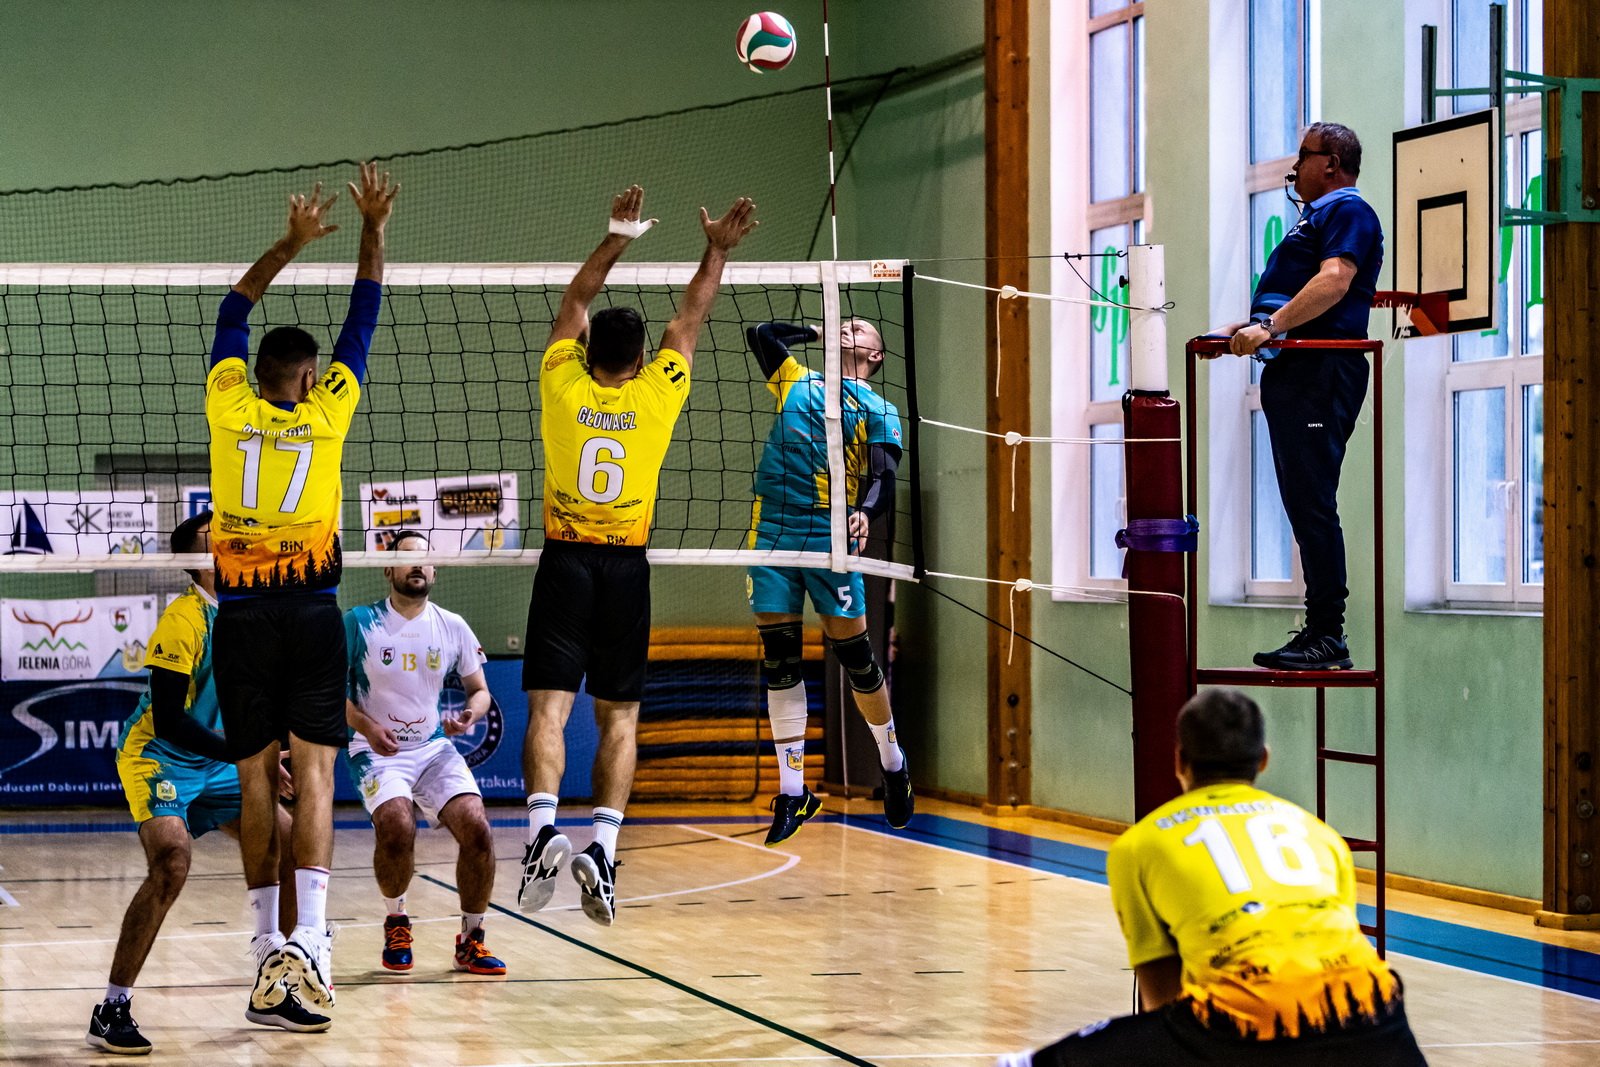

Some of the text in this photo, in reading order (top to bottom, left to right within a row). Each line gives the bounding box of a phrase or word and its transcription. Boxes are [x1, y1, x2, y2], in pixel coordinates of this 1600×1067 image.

[577, 406, 637, 431] GŁOWACZ
[237, 433, 314, 513] 17
[577, 436, 627, 504] 6
[106, 520, 154, 528] DESIGN
[107, 511, 134, 519] NEW
[280, 540, 304, 552] BiN
[837, 585, 852, 611] 5
[18, 653, 91, 671] JELENIA GÓRA
[401, 653, 418, 671] 13
[48, 782, 89, 794] Dobrej
